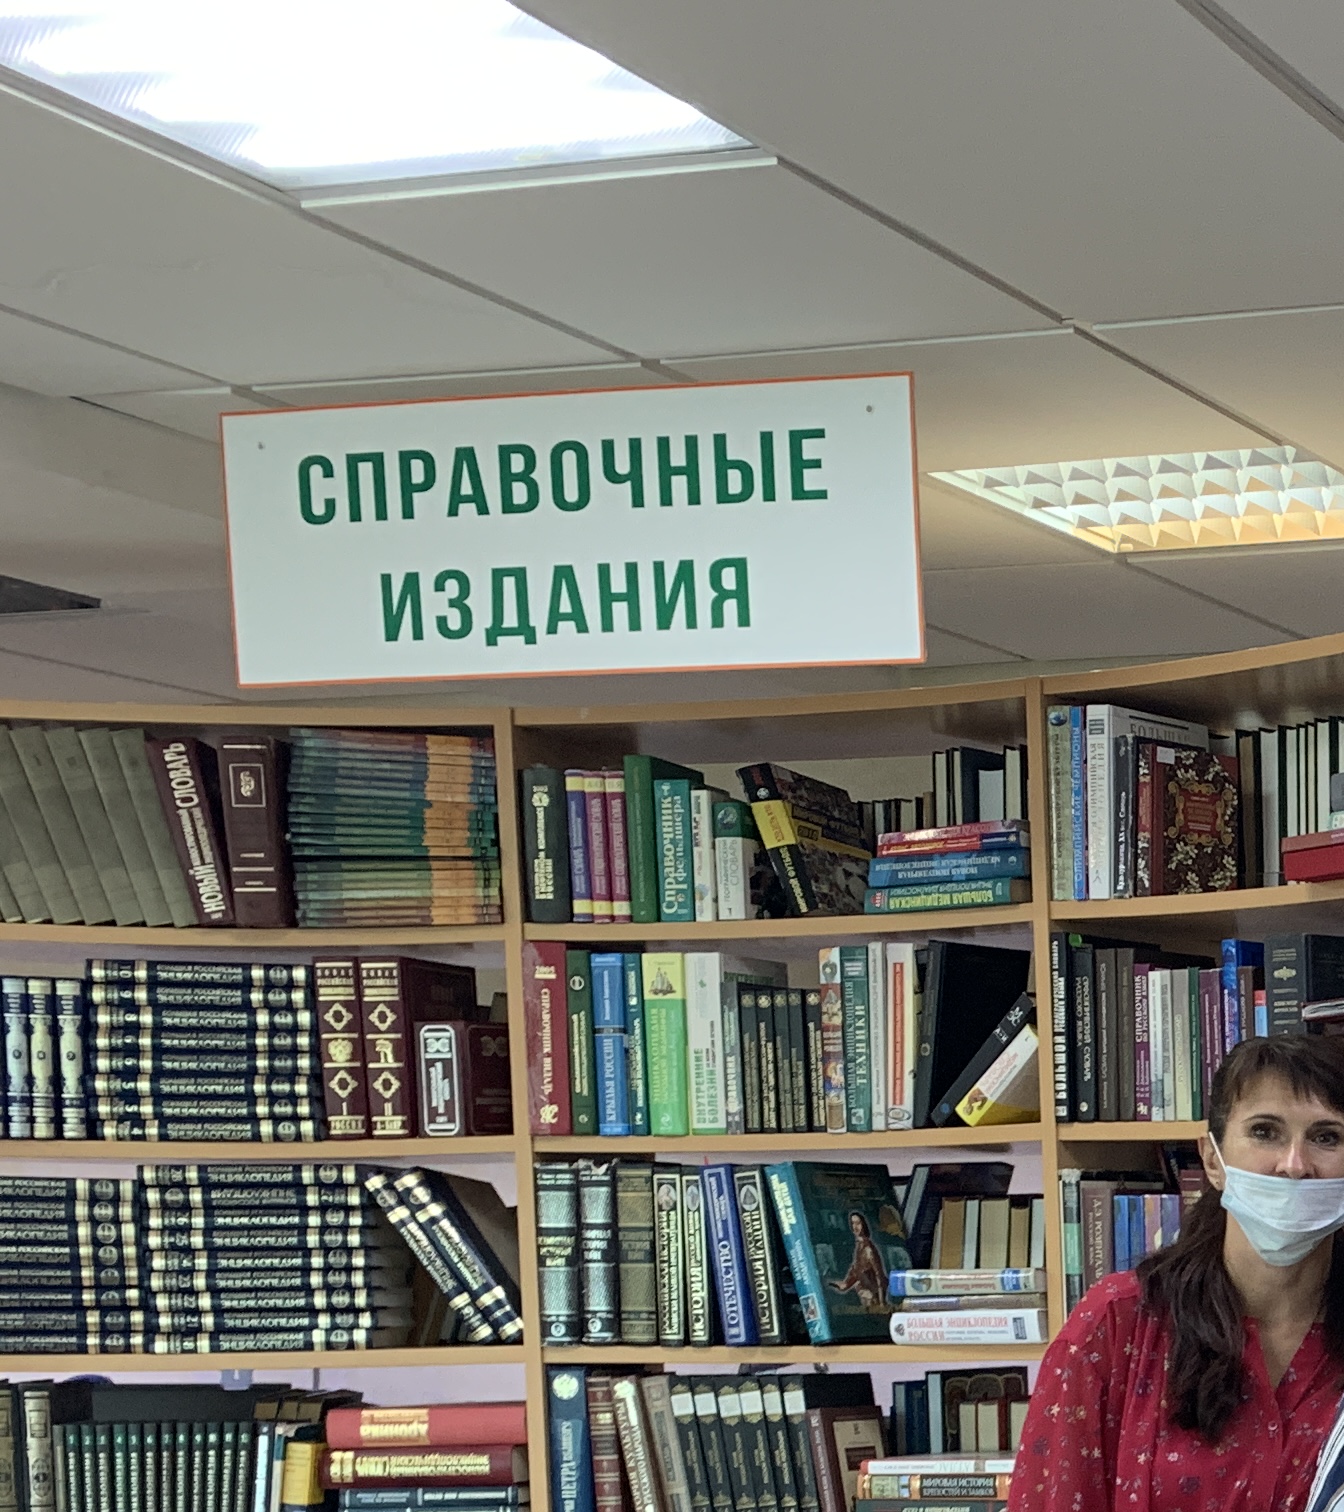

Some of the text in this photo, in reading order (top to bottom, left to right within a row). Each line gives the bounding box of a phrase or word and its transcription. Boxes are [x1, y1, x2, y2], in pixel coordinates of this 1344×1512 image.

[296, 426, 829, 526] СПРАВОЧНЫЕ
[378, 556, 754, 648] ИЗДАНИЯ
[661, 797, 687, 914] Справочник
[602, 1037, 617, 1122] КРЫЛЬЯ РОССИИ
[853, 1004, 867, 1086] ТЕХНИКИ
[718, 1241, 739, 1324] ОТЕЧЕСТВО
